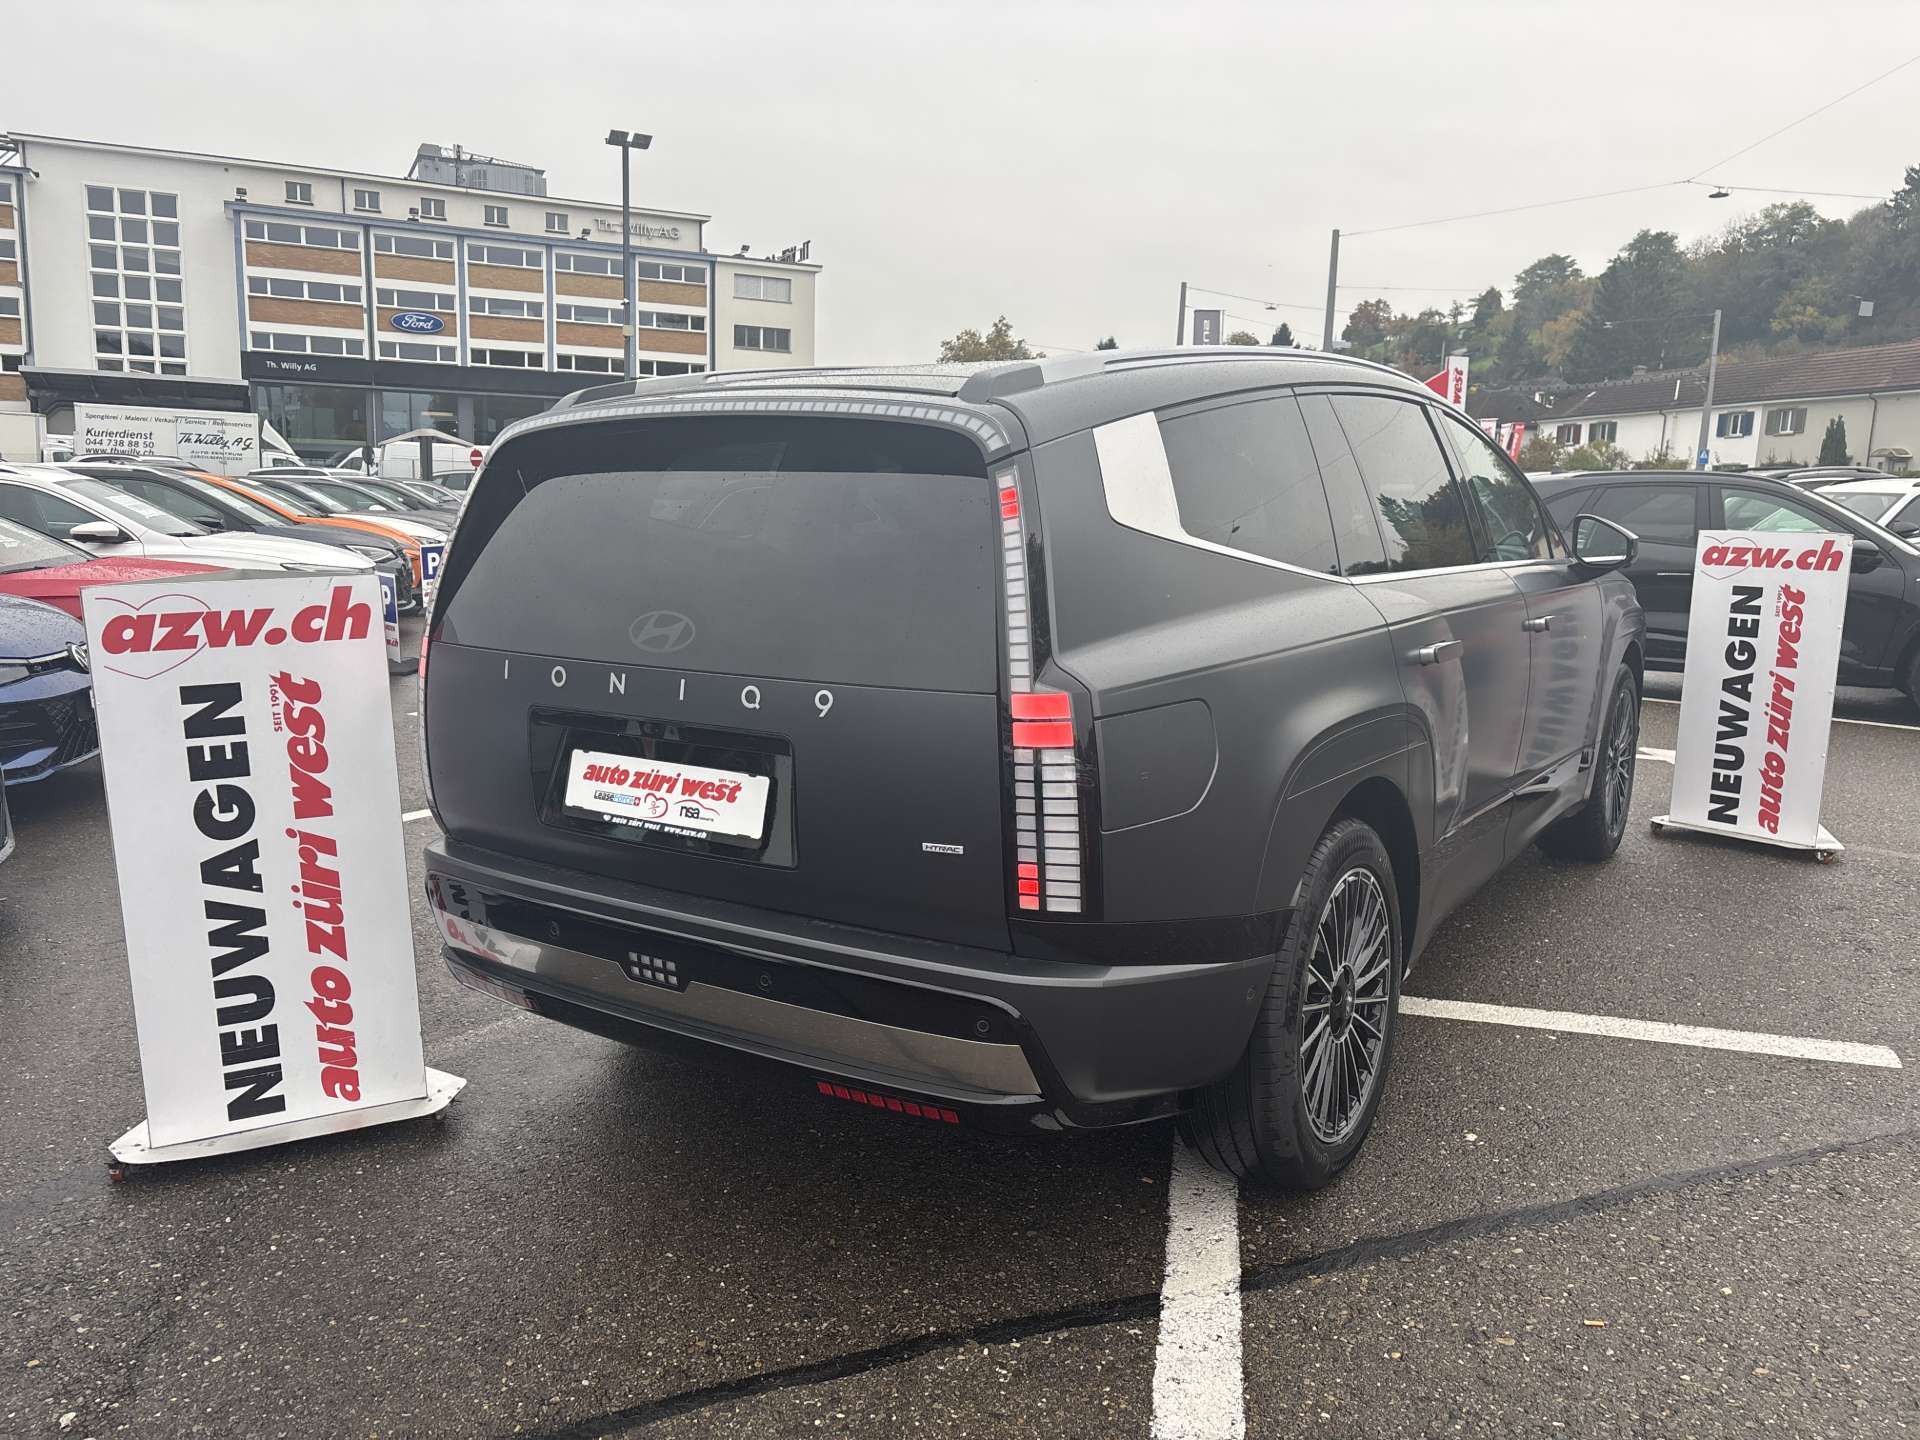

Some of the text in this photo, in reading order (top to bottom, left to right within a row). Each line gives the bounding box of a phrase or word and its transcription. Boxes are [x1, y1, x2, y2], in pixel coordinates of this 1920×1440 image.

[659, 225, 680, 240] AG
[401, 314, 434, 330] Ford
[265, 360, 317, 372] Th. Willy AG
[85, 412, 118, 421] Spenglerei
[184, 418, 206, 426] Service
[85, 427, 153, 441] Kurierdienst
[85, 438, 155, 449] 044 738 88 50
[231, 437, 254, 450] AG
[427, 552, 440, 575] P
[1701, 540, 1844, 571] azw.ch
[381, 585, 391, 615] P
[101, 585, 372, 655] azw.ch
[269, 683, 283, 732] SEIT 1991
[814, 689, 834, 718] 9
[1707, 585, 1764, 825] NEUWAGEN
[1758, 583, 1806, 835] auto züri west
[583, 764, 743, 803] auto züri west
[680, 805, 700, 819] nsa
[269, 670, 361, 1102] auto züri west
[179, 682, 286, 1122] NEUWAGEN
